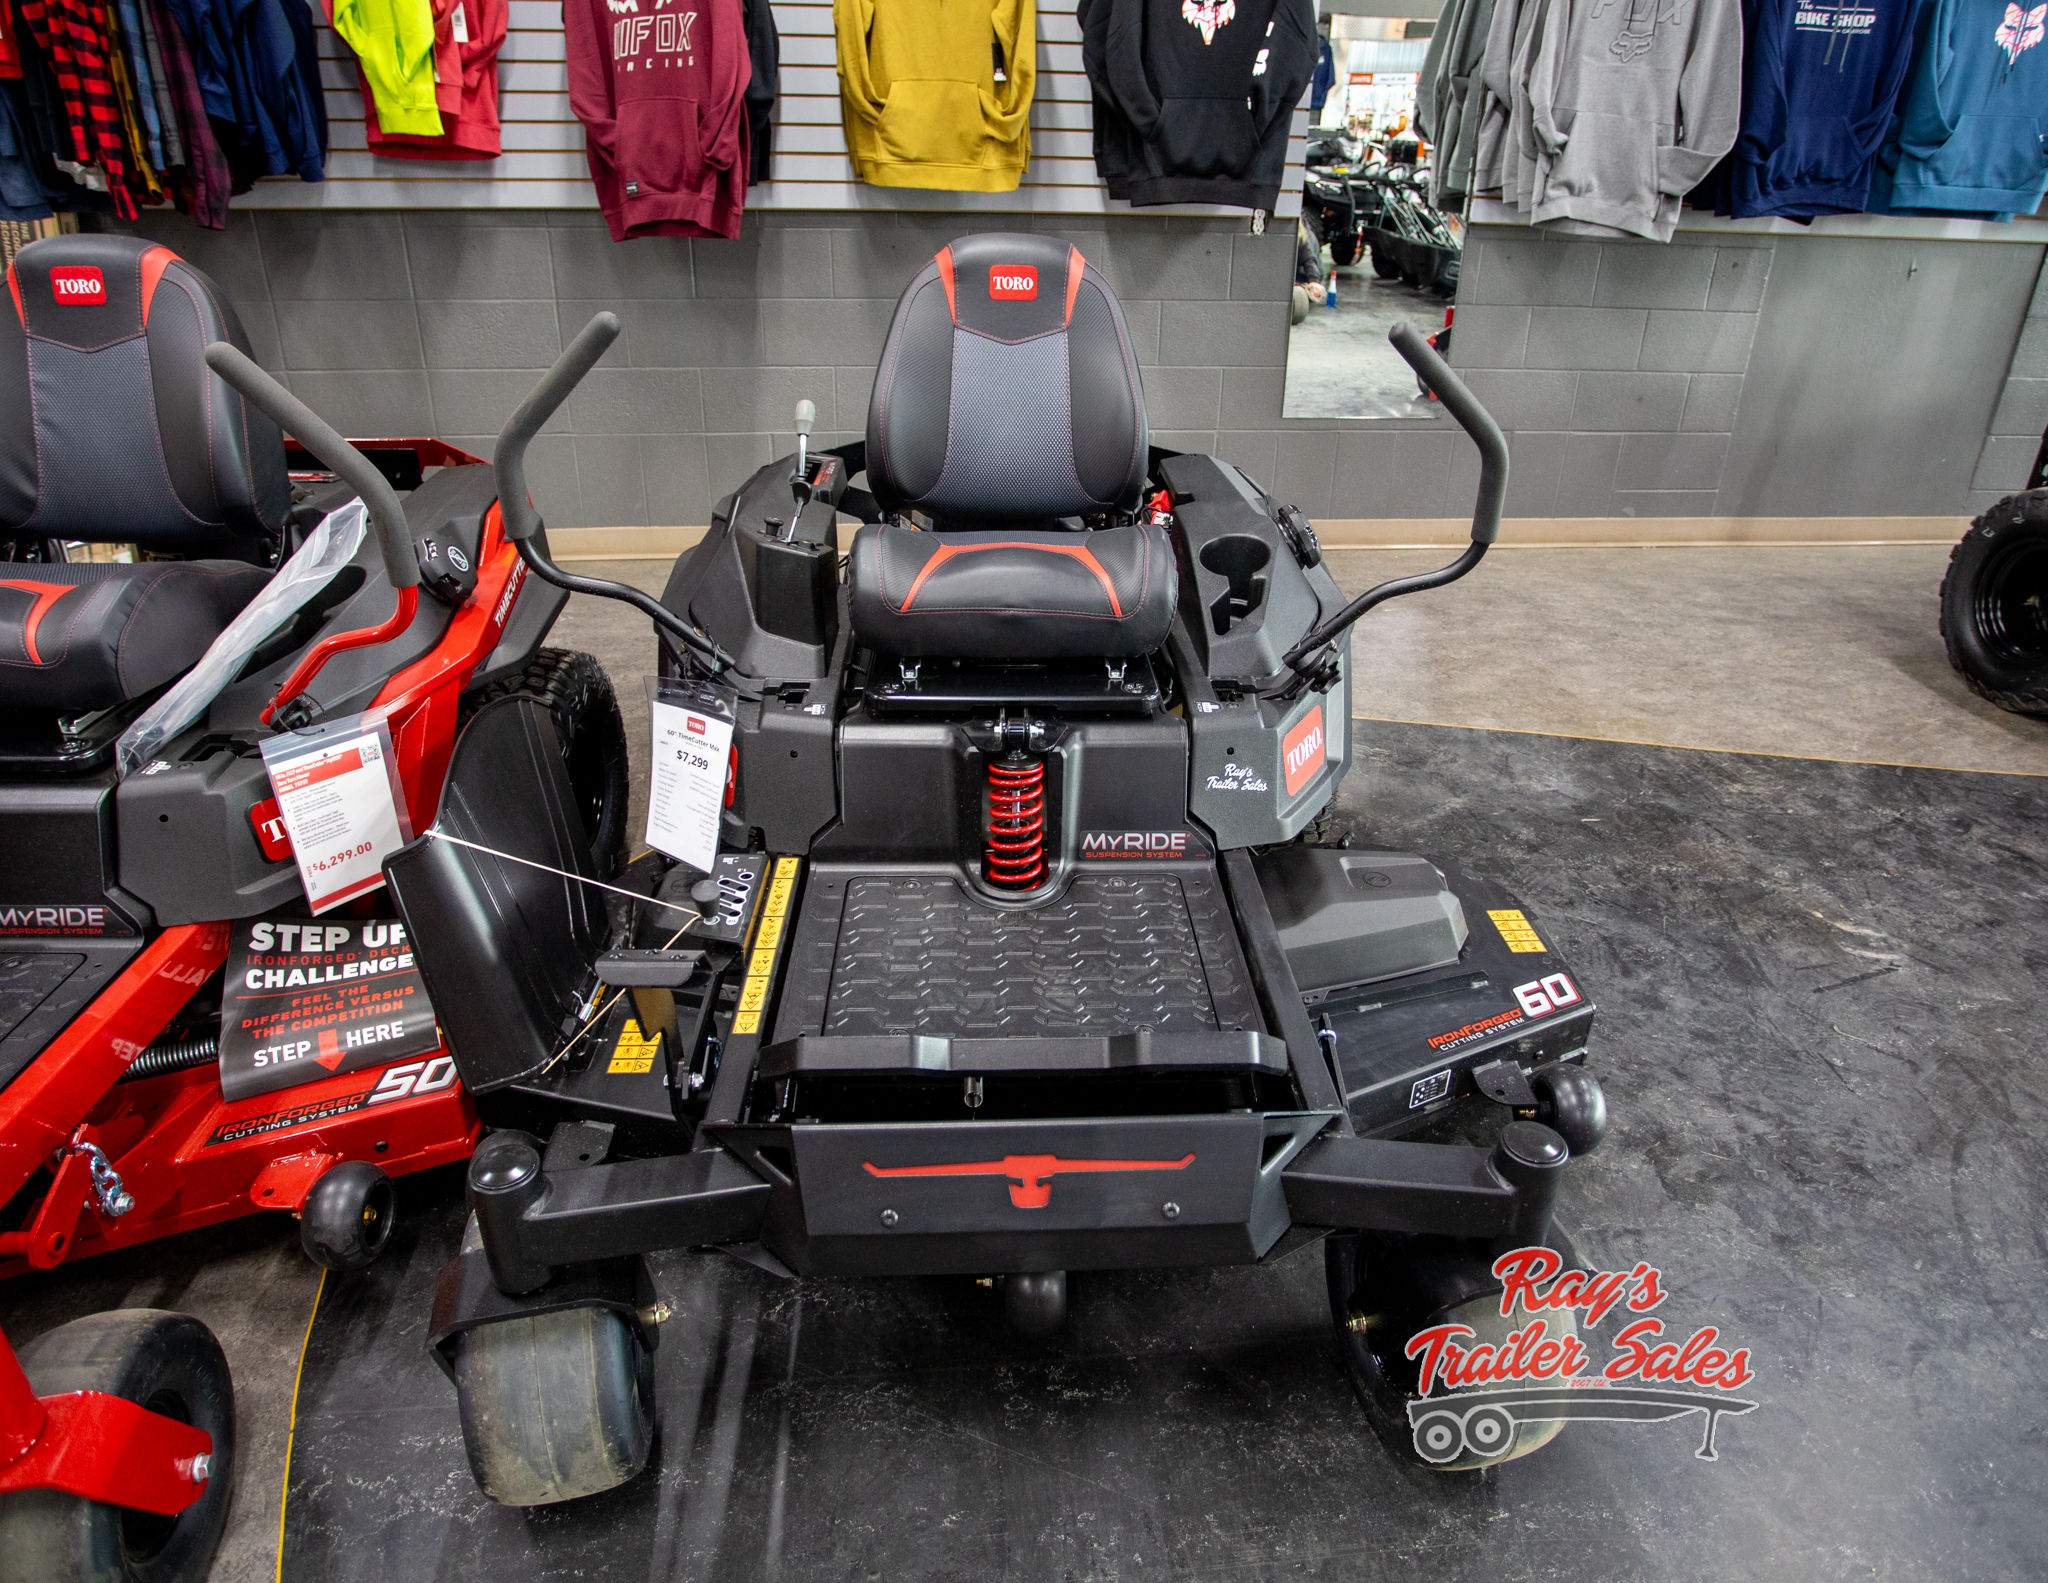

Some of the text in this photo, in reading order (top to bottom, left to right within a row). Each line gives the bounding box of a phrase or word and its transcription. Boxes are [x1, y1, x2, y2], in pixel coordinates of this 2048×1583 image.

[1794, 11, 1876, 28] BIKE SHOP
[55, 278, 101, 294] TORO
[993, 276, 1034, 290] TORO
[678, 732, 708, 747] TimeCutter
[676, 750, 709, 770] $7,299
[1287, 726, 1321, 776] TORO
[1224, 763, 1253, 780] Ray's
[1206, 775, 1268, 792] Trailer Sales
[1085, 851, 1183, 859] SUSPENSION SYSTEM
[63, 927, 104, 935] SYSTEM
[249, 922, 350, 952] STEP
[369, 945, 410, 958] DECK
[245, 953, 414, 989] CHALLENGE
[292, 985, 369, 1007] FEEL THE
[1512, 972, 1582, 1019] 60
[241, 986, 415, 1029] DIFFERENCE VERSUS
[252, 1000, 403, 1039] THE COMPETITION
[253, 1021, 405, 1067] STEP HERE
[1439, 1017, 1525, 1051] CUTTING SYSTEM
[367, 1055, 458, 1106] 50
[224, 1103, 359, 1141] CUTTING SYSTEM
